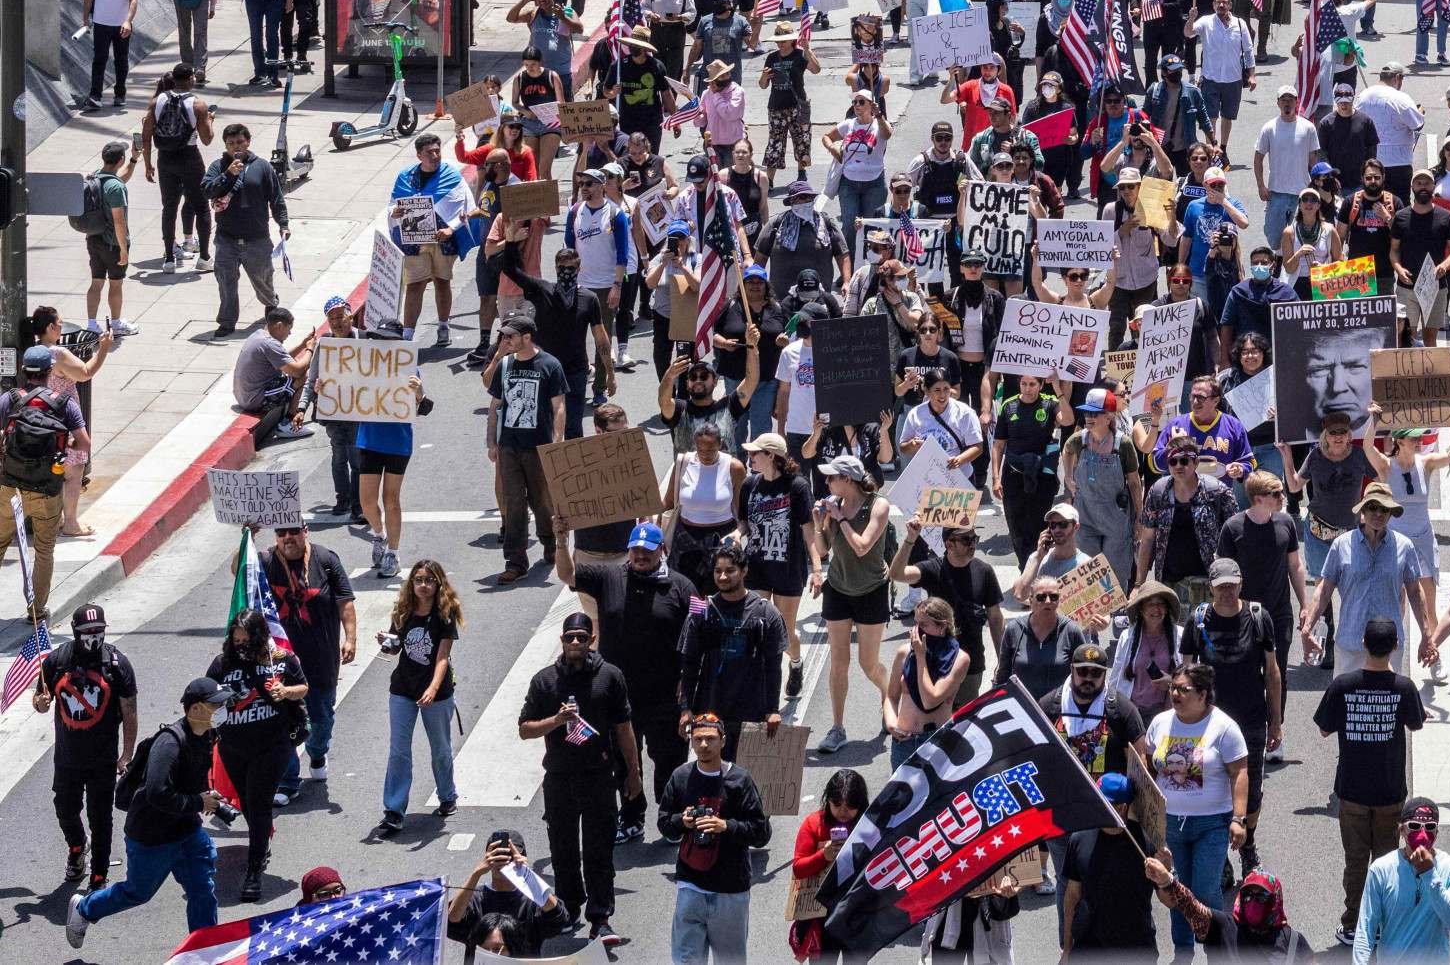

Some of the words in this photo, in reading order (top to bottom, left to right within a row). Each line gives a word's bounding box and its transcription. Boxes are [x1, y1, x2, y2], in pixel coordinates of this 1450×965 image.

[916, 19, 943, 36] Fuck
[919, 53, 946, 72] Fuck
[937, 196, 952, 204] PRESS
[970, 183, 1029, 215] COME
[576, 226, 603, 240] Dodgers
[969, 225, 1026, 259] CULO
[1038, 252, 1071, 262] FRONTAL
[1077, 251, 1113, 263] CORTEX
[1320, 273, 1366, 293] FREEDOM
[1018, 303, 1051, 326] 80
[1059, 311, 1097, 328] AND
[1153, 305, 1189, 326] MAKE
[1276, 304, 1348, 321] CONVICTED
[1352, 299, 1393, 316] FELON
[1303, 320, 1321, 330] MAY
[1325, 319, 1340, 330] 30,
[1344, 316, 1367, 327] 2024
[1000, 330, 1054, 350] THROWING
[320, 344, 415, 379] TRUMP
[996, 350, 1064, 369] TANTRUMS!
[1109, 353, 1127, 363] KEEP
[1146, 344, 1186, 368] AFRAID
[1394, 351, 1416, 376] ICE
[1420, 350, 1434, 375] IS
[1385, 379, 1412, 400] BEST
[1418, 377, 1449, 398] WHEN
[317, 378, 414, 420] SUCKS
[545, 439, 602, 482] ICE
[212, 472, 238, 487] THIS
[244, 472, 259, 486] IS
[267, 473, 292, 486] THE
[214, 486, 274, 501] MACHINE
[928, 489, 974, 509] DUMP
[220, 500, 239, 512] THEY
[240, 500, 266, 513] TOLD
[267, 501, 290, 512] YOU
[923, 506, 961, 524] TRUMP
[256, 510, 302, 526] AGAINST
[1078, 558, 1102, 578] LIKE
[1344, 694, 1366, 703] YOU'RE
[1367, 694, 1401, 704] AFFILIATED
[1347, 704, 1355, 712] TO
[1356, 704, 1390, 713] SOMETHING
[1346, 723, 1355, 732] NO
[1356, 723, 1380, 732] MATTER
[1347, 714, 1380, 722] SOMEONE'S
[1346, 732, 1361, 741] YOUR
